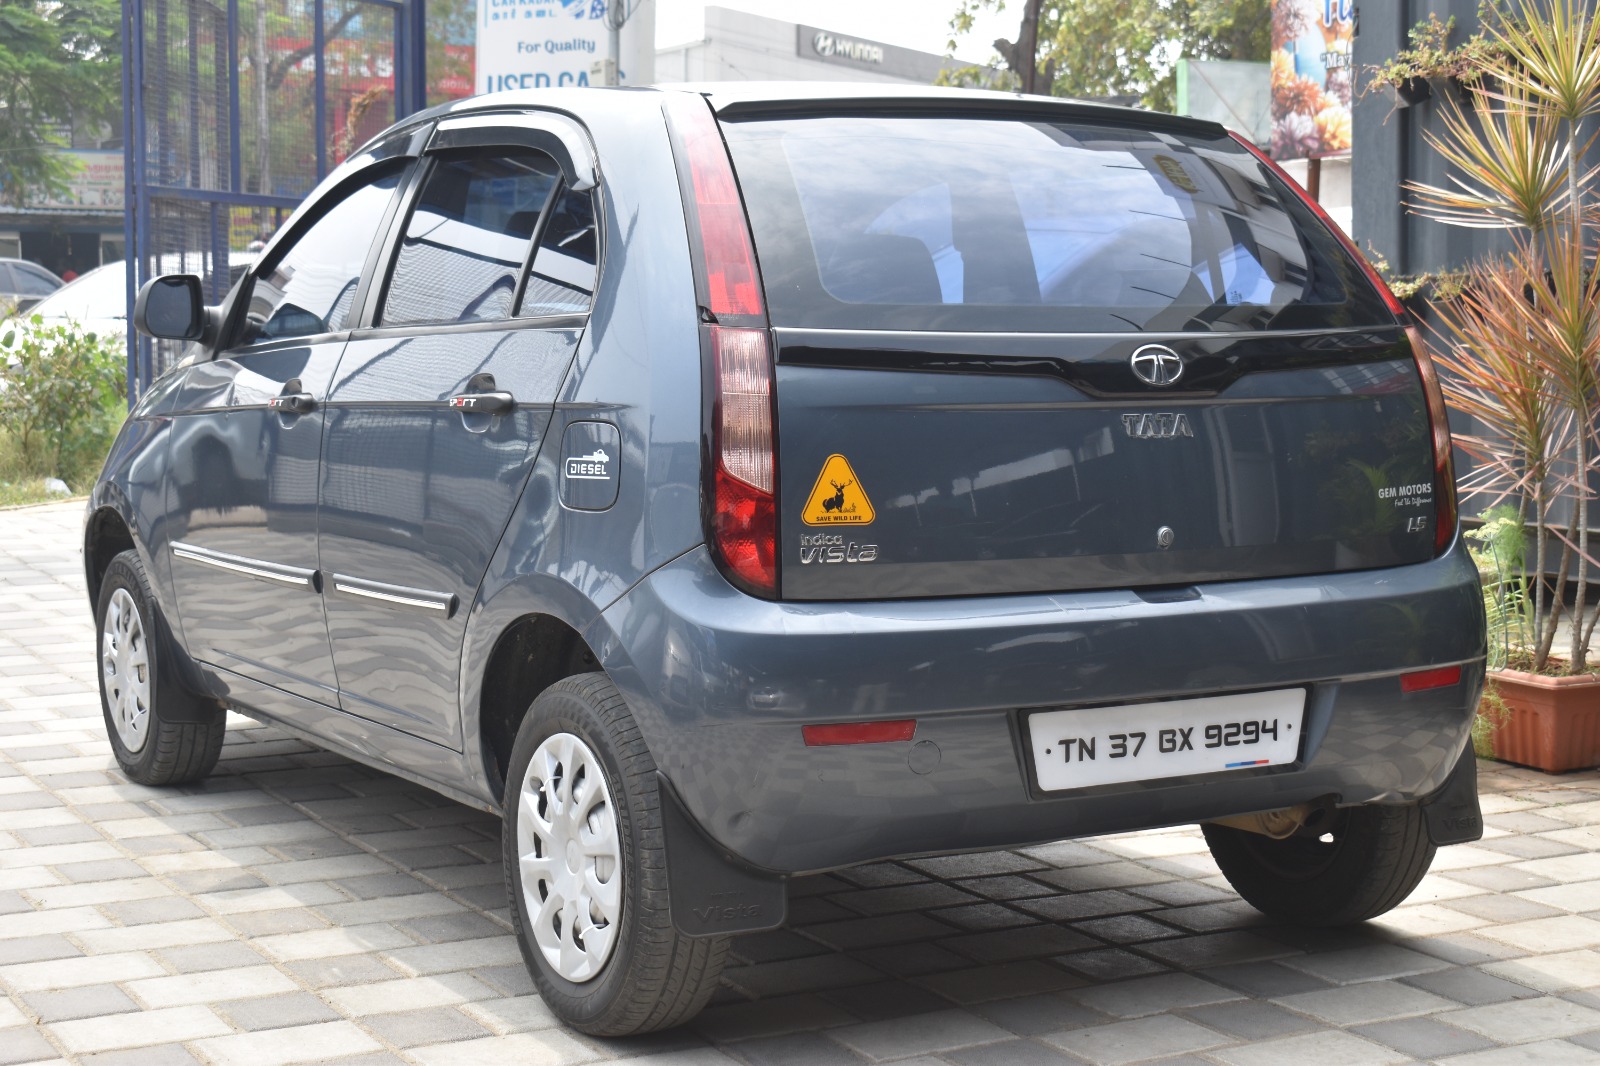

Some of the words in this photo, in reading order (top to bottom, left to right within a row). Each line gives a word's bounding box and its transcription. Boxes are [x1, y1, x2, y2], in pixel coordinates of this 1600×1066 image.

[517, 41, 541, 54] For
[544, 38, 596, 53] Quality
[1122, 412, 1194, 438] TATA
[570, 463, 607, 475] DIESEL
[1378, 487, 1397, 499] GEM
[1398, 483, 1432, 497] MOTORS
[1058, 736, 1096, 763] TN
[1109, 731, 1147, 759] 37
[1158, 726, 1194, 753] BX
[1204, 718, 1278, 749] 9294
